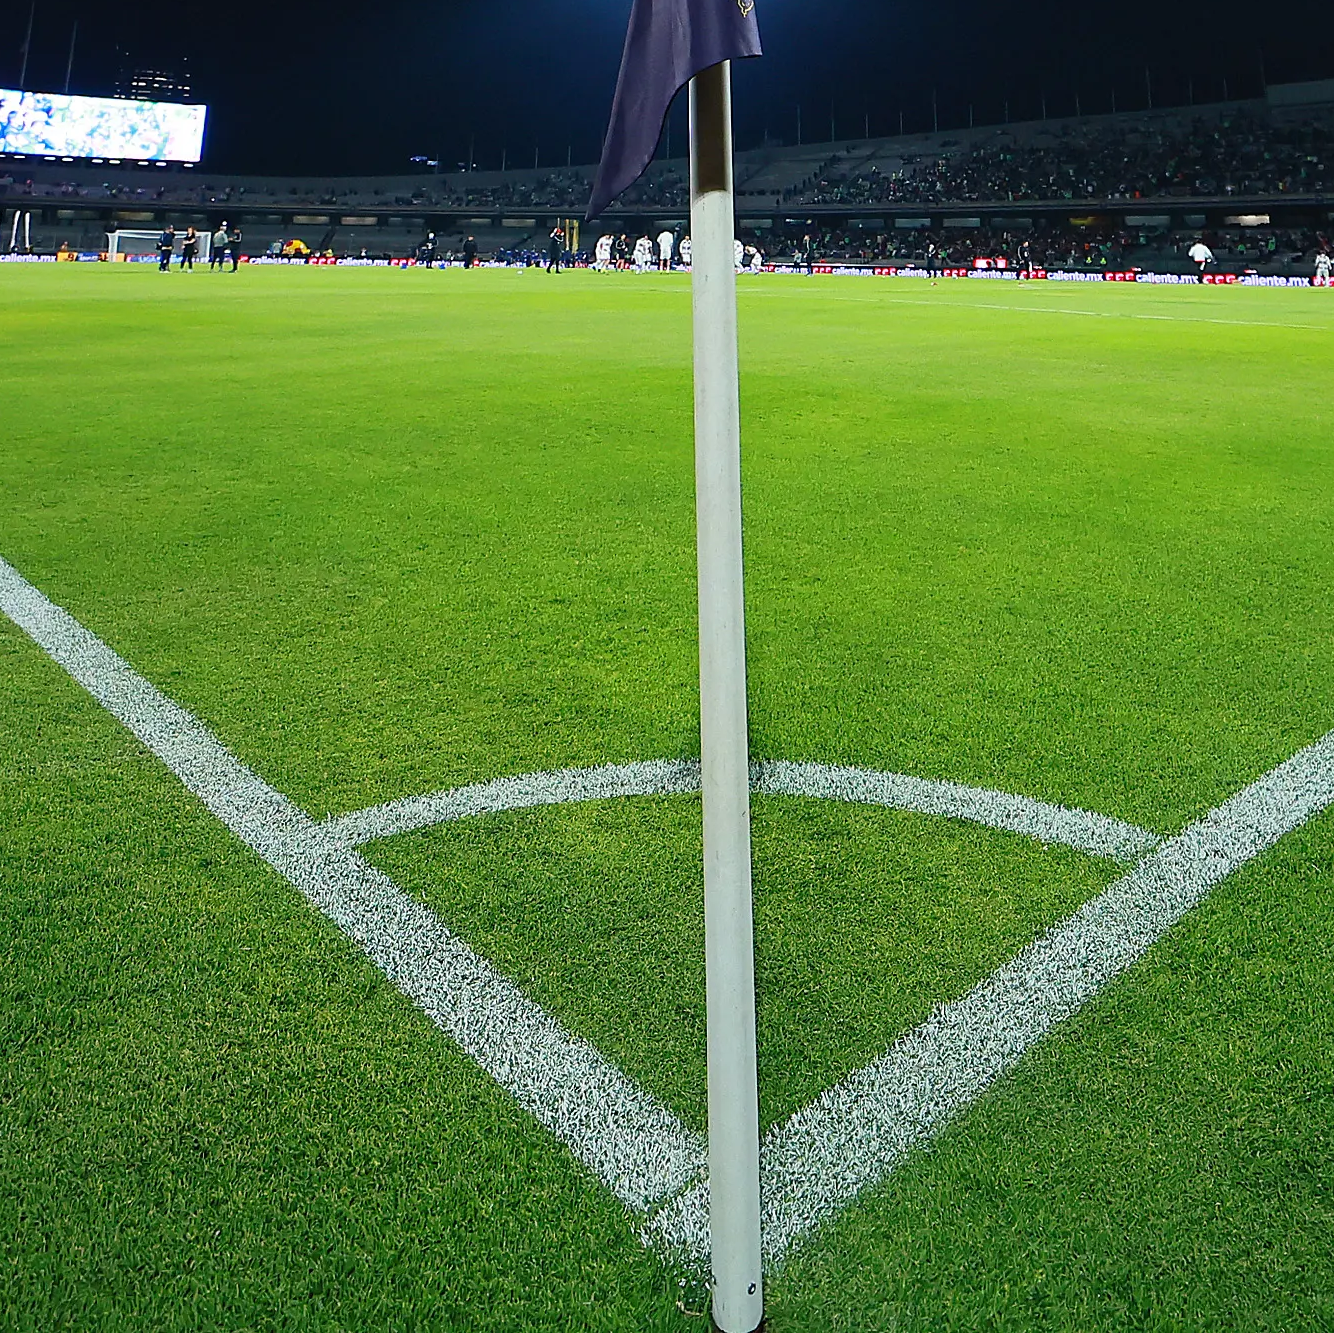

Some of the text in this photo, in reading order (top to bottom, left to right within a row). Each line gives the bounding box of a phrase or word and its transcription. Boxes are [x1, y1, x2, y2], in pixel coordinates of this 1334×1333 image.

[967, 267, 1017, 279] caliente.mx
[1047, 271, 1103, 282] caliente.mx
[1135, 272, 1199, 284] caliente.mx
[1238, 274, 1310, 287] caliente.mx
